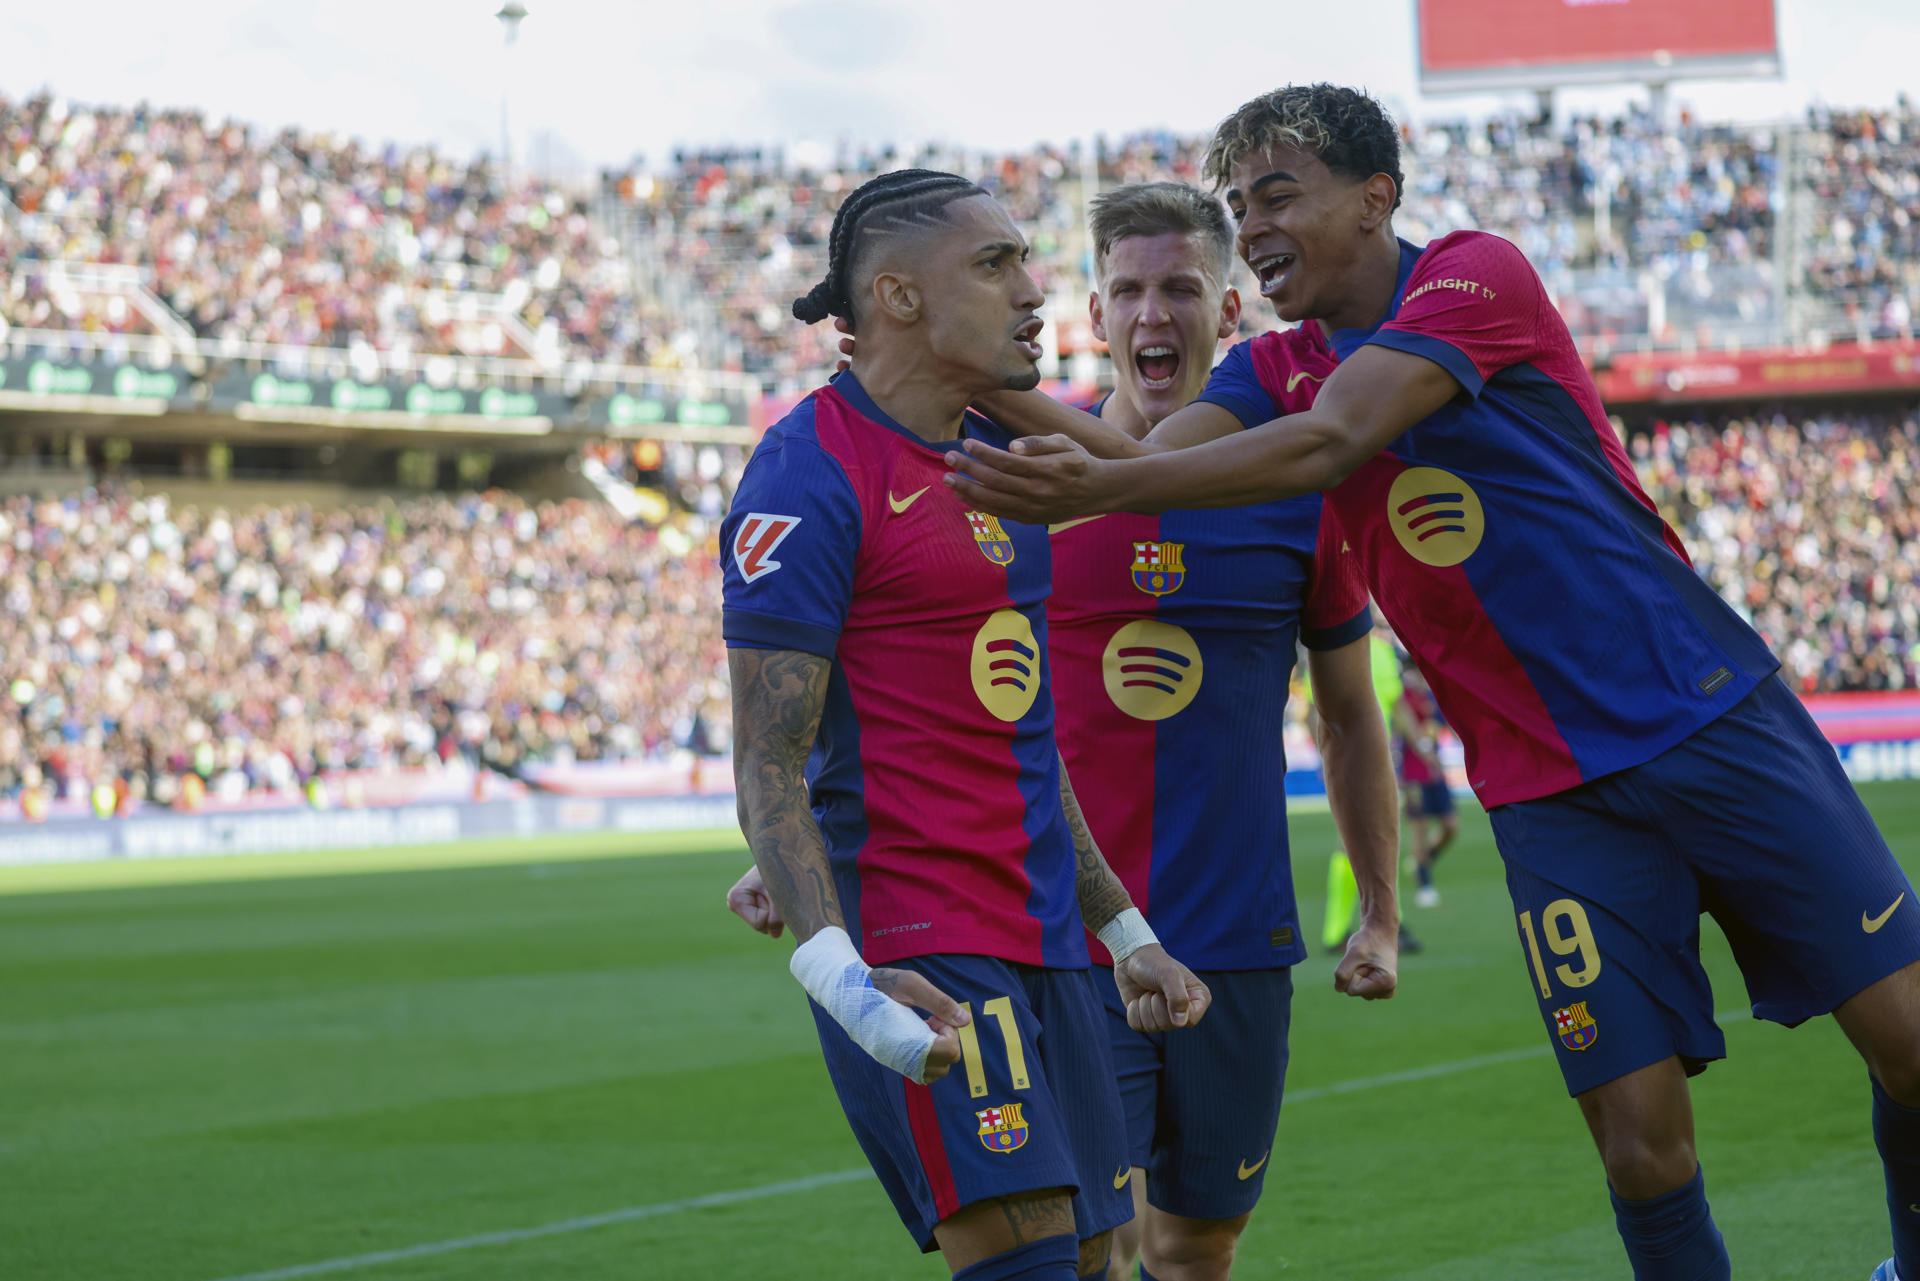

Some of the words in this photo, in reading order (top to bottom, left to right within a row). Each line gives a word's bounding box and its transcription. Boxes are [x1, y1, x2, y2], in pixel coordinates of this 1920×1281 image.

[1402, 278, 1480, 307] MBILIGHT
[1483, 286, 1497, 300] tv
[1147, 563, 1169, 572] FCB
[1519, 898, 1602, 1000] 19
[957, 995, 1031, 1099] 11
[992, 1123, 1013, 1132] FCB
